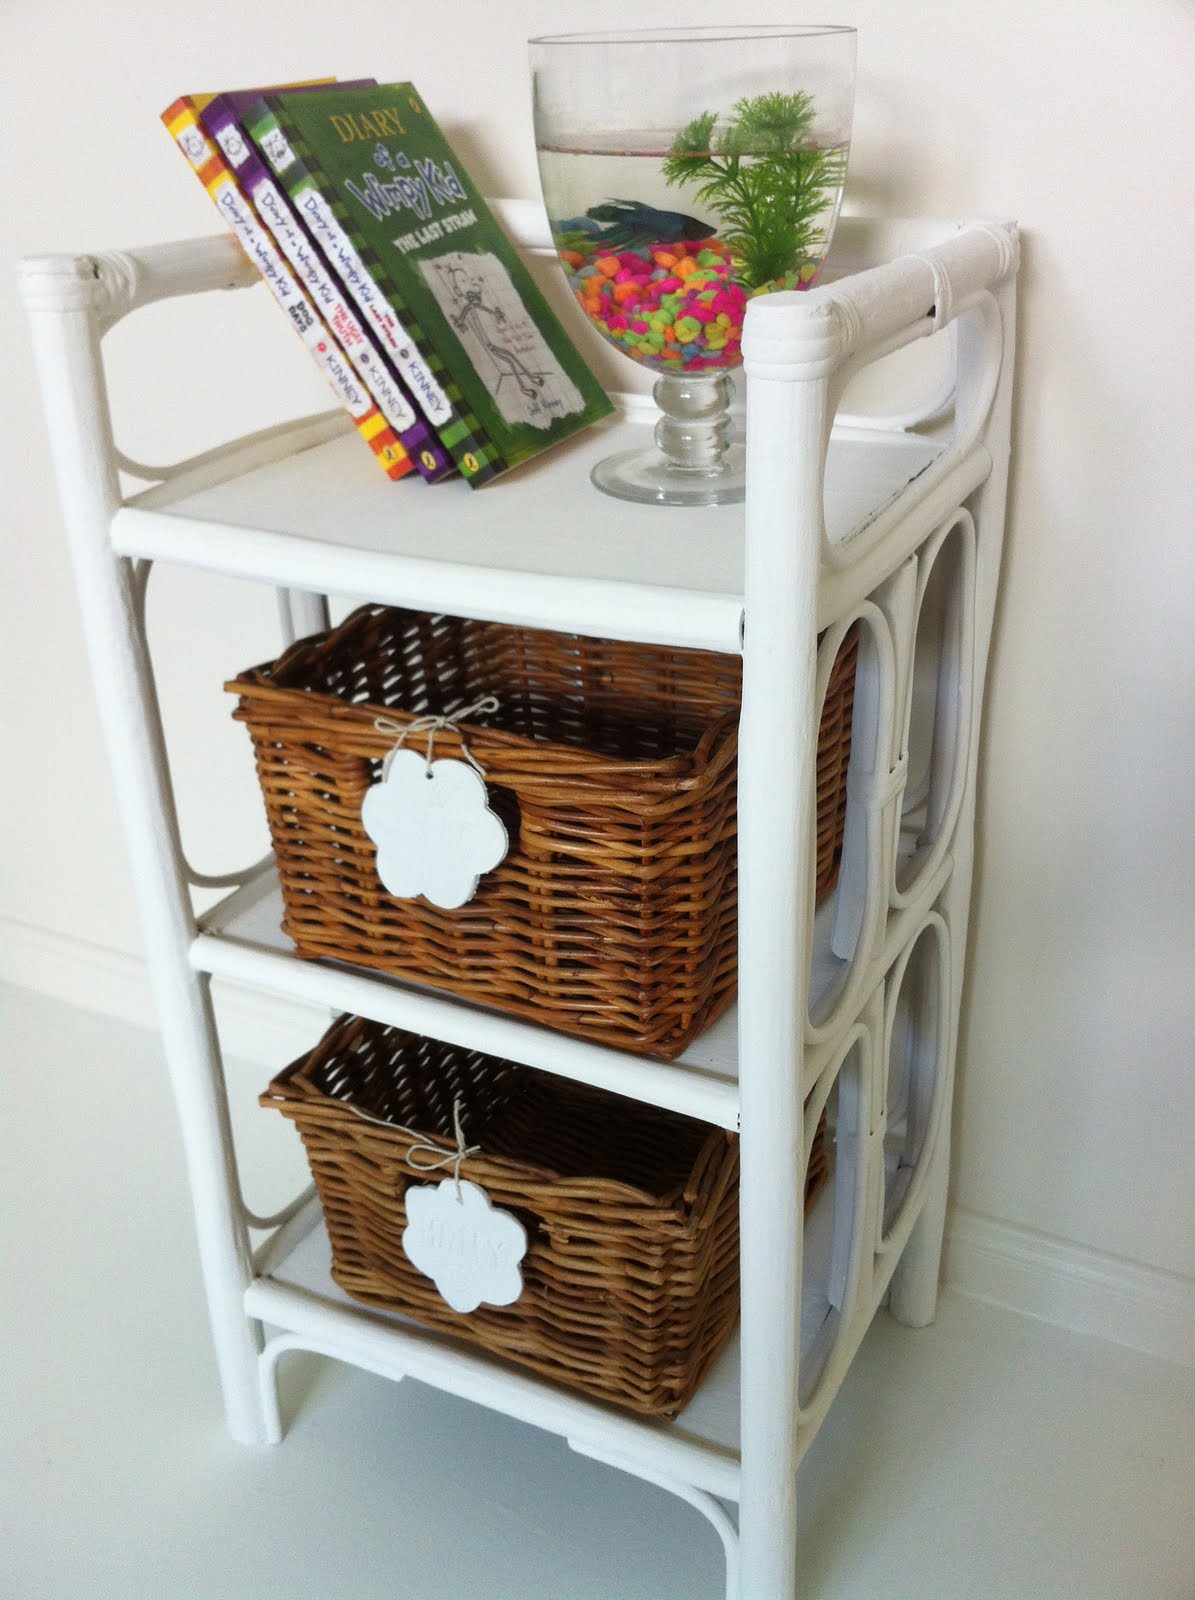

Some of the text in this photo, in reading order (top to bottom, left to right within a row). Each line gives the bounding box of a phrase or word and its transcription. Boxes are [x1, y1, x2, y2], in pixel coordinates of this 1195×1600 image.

[329, 107, 407, 144] DIARY
[373, 142, 411, 171] of a
[344, 157, 467, 222] Wimpy Kid
[221, 191, 246, 224] Diary
[275, 276, 291, 297] Kid
[262, 191, 287, 226] Diary
[318, 283, 335, 304] Kid
[304, 196, 329, 229] Diary
[358, 283, 375, 303] Kid
[392, 208, 478, 254] THE LAST STRAW
[287, 304, 307, 333] DAYS
[296, 300, 314, 327] DOG
[326, 354, 362, 405] KINNEY
[369, 365, 406, 418] KINNEY
[409, 361, 444, 411] KINNEY
